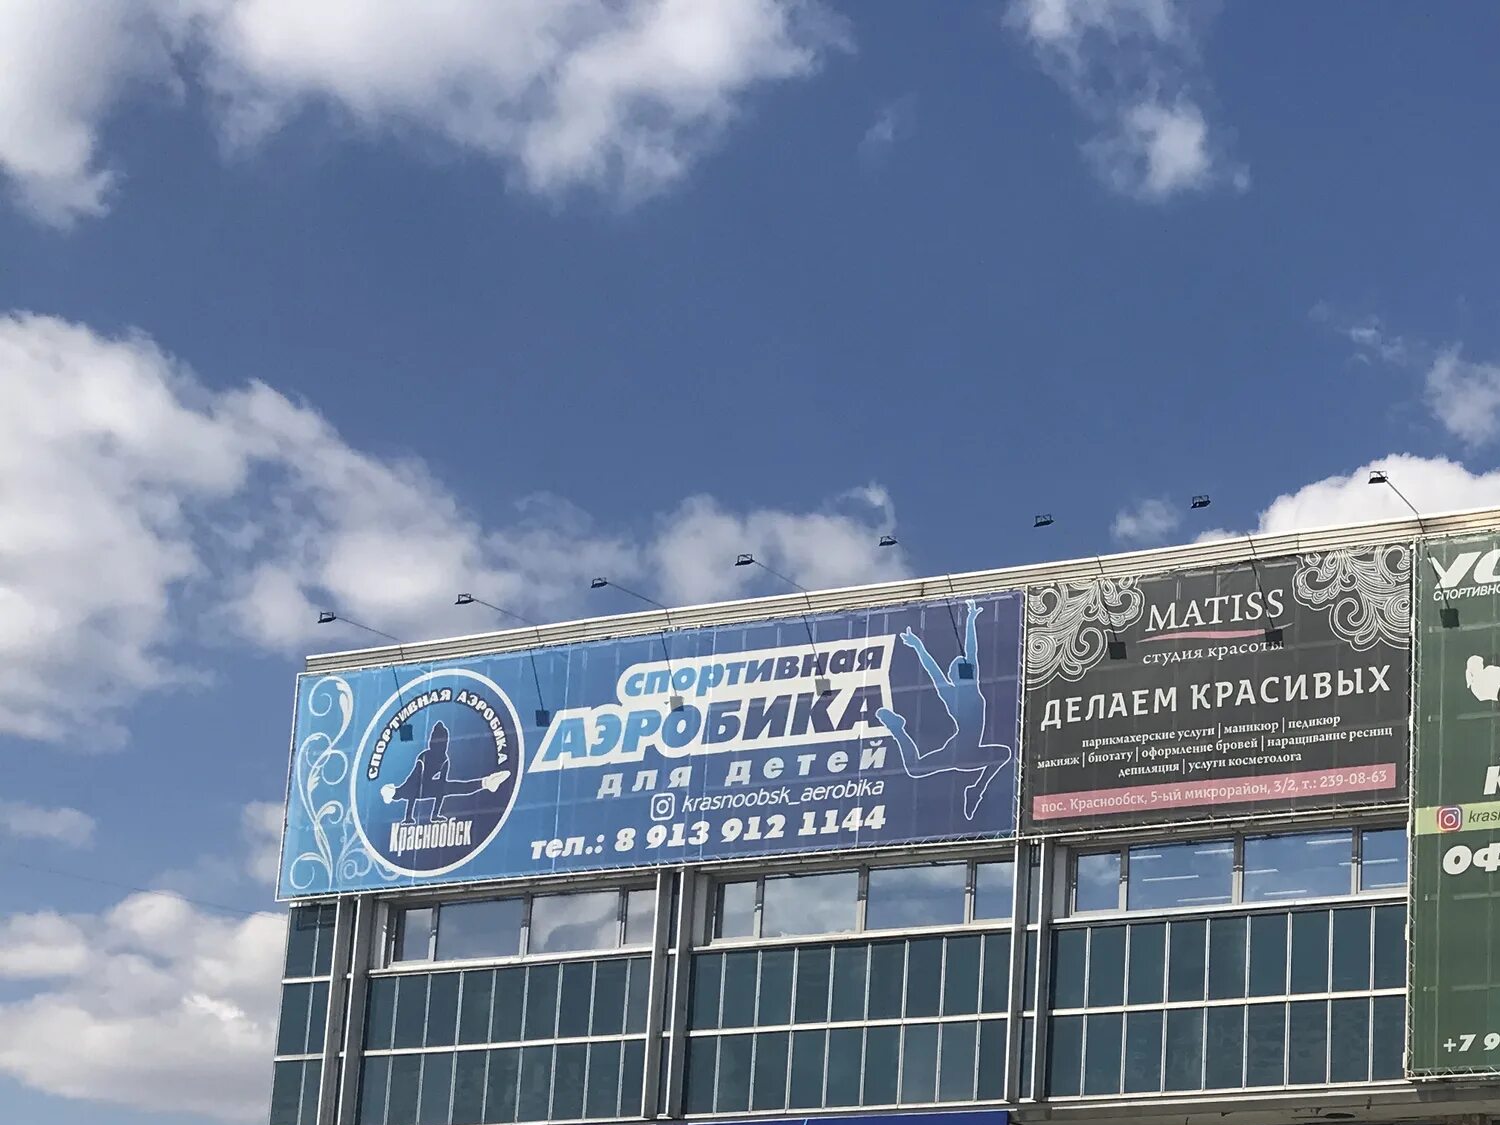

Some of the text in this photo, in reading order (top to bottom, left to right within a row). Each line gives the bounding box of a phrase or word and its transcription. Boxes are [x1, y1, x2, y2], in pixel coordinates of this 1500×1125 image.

[1145, 589, 1284, 632] MATISS
[1143, 641, 1284, 666] студия красоты
[1040, 665, 1391, 731] ДЕЛАЕМ КРАСИВЫХ
[367, 689, 508, 780] СПОРТИВНАЯ АЭРОБИКА
[543, 685, 882, 761] АЭРОБИКА
[1082, 716, 1341, 750] парикмахерские услуги маникюр педикюр
[1037, 727, 1393, 769] макияж биотату оформление бровей наращивание ресниц
[1118, 752, 1302, 778] депиляция услуги косметолога
[597, 741, 886, 799] для детей
[1041, 802, 1067, 813] пос.
[1070, 792, 1147, 812] Краснообск,
[1151, 788, 1182, 802] 5-ый
[1184, 782, 1270, 801] микрорайон,
[1273, 776, 1299, 793] 3/2,
[1320, 769, 1387, 789] 239-08-63
[682, 778, 884, 813] krasnoobsk_aerobika
[389, 817, 473, 856] Краснообск
[615, 827, 636, 852] 8
[646, 818, 709, 849] 913
[721, 814, 784, 841] 912
[798, 804, 886, 835] 1144
[1443, 1034, 1477, 1052] +7
